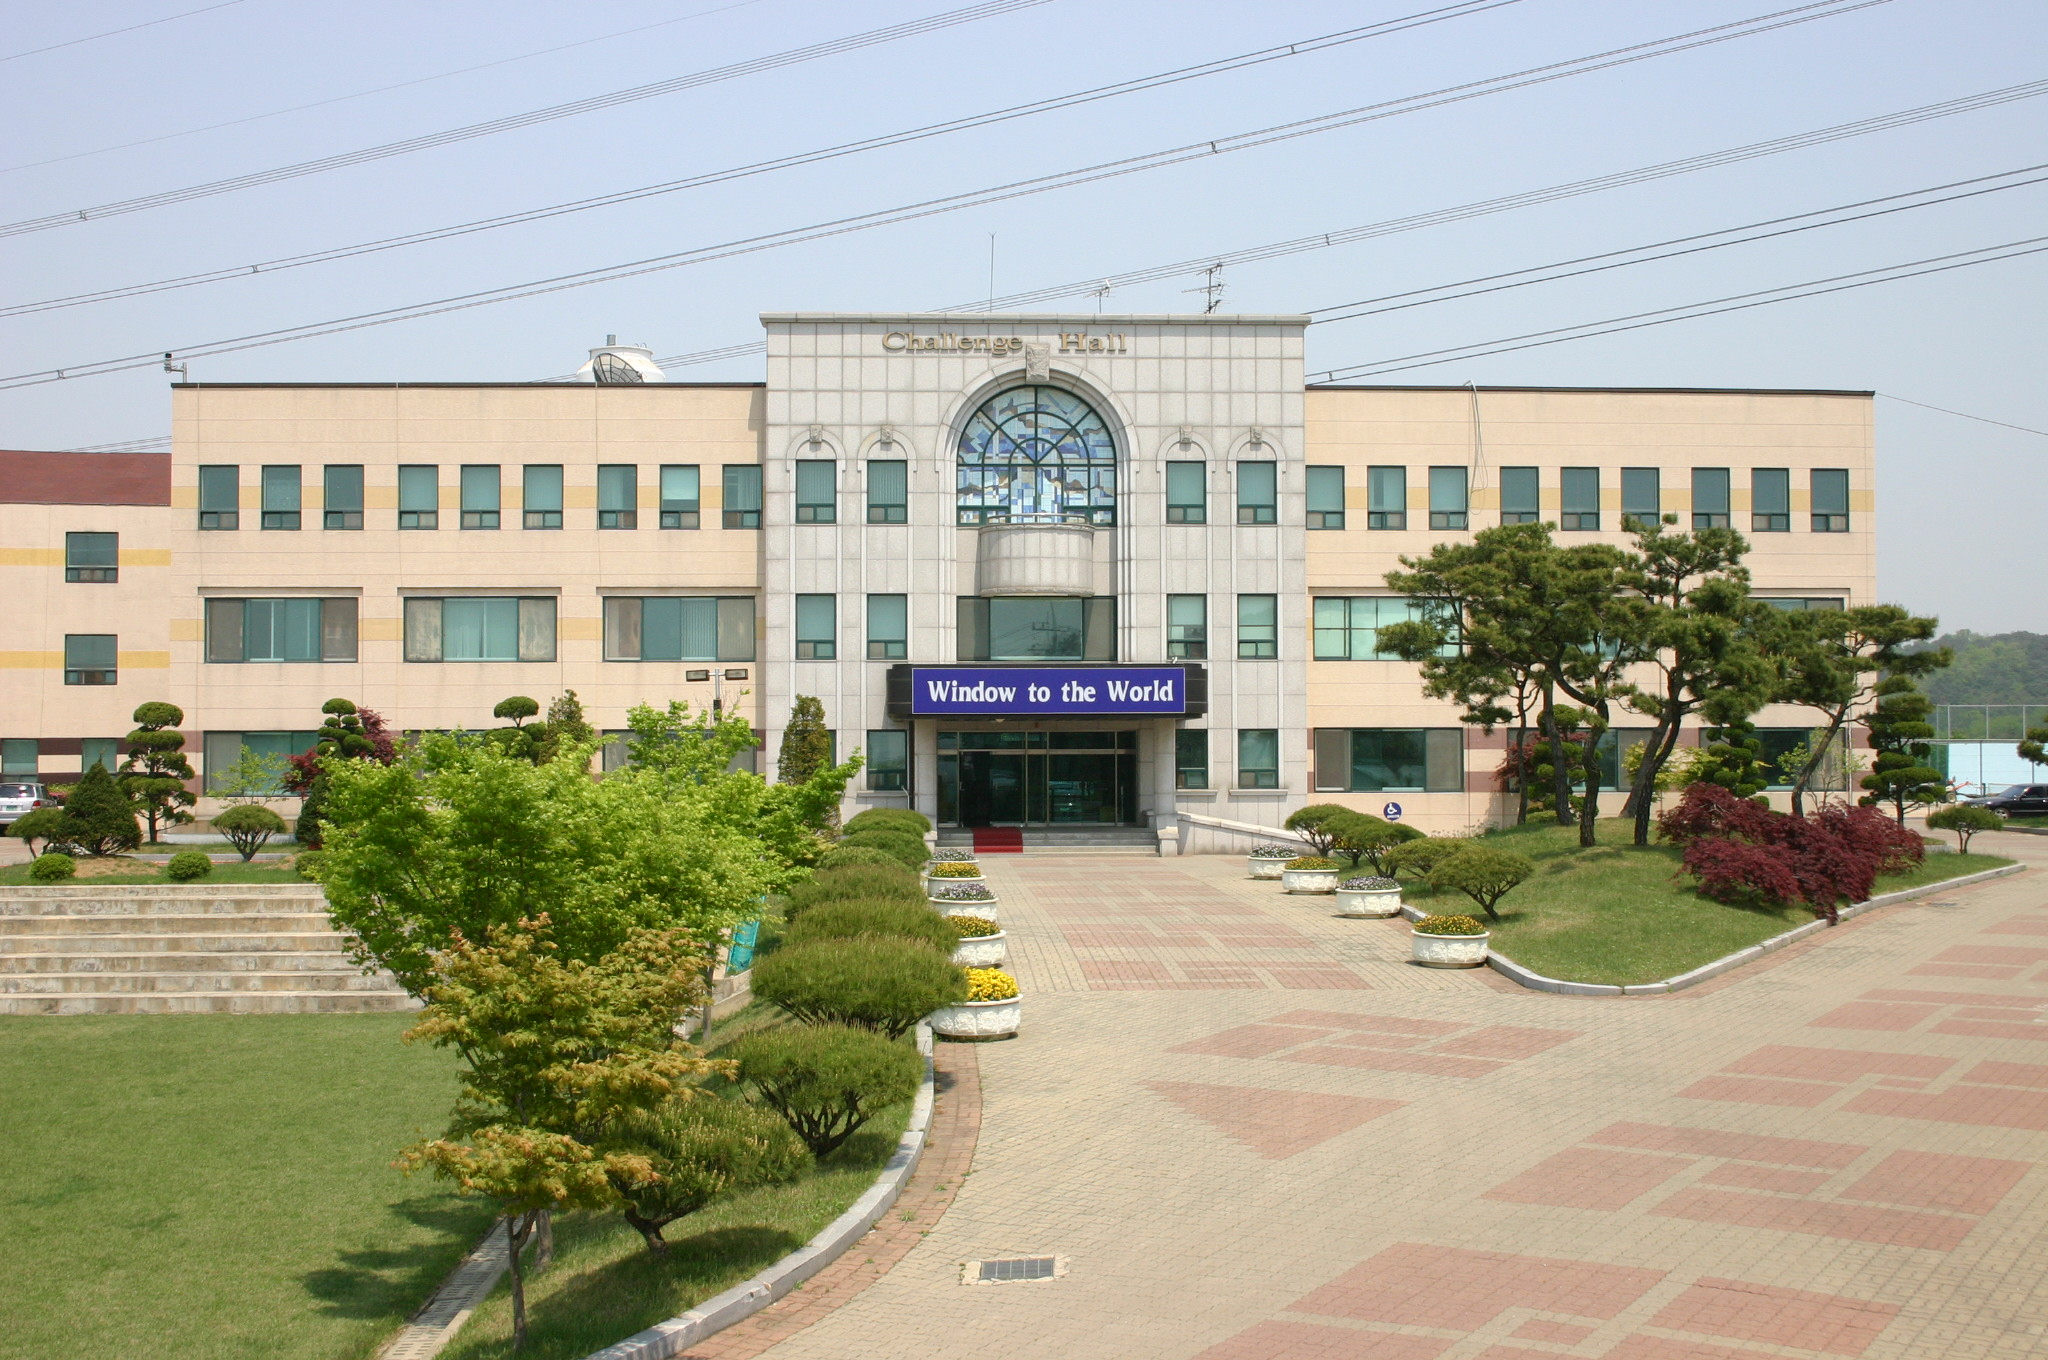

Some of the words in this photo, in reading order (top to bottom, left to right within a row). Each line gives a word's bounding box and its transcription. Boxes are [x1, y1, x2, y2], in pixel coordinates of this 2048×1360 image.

[883, 332, 1023, 354] Challenge
[1059, 333, 1127, 352] Hall
[927, 680, 1017, 702] Window
[1028, 682, 1051, 702] to
[1061, 680, 1096, 702] the
[1107, 679, 1174, 702] World
